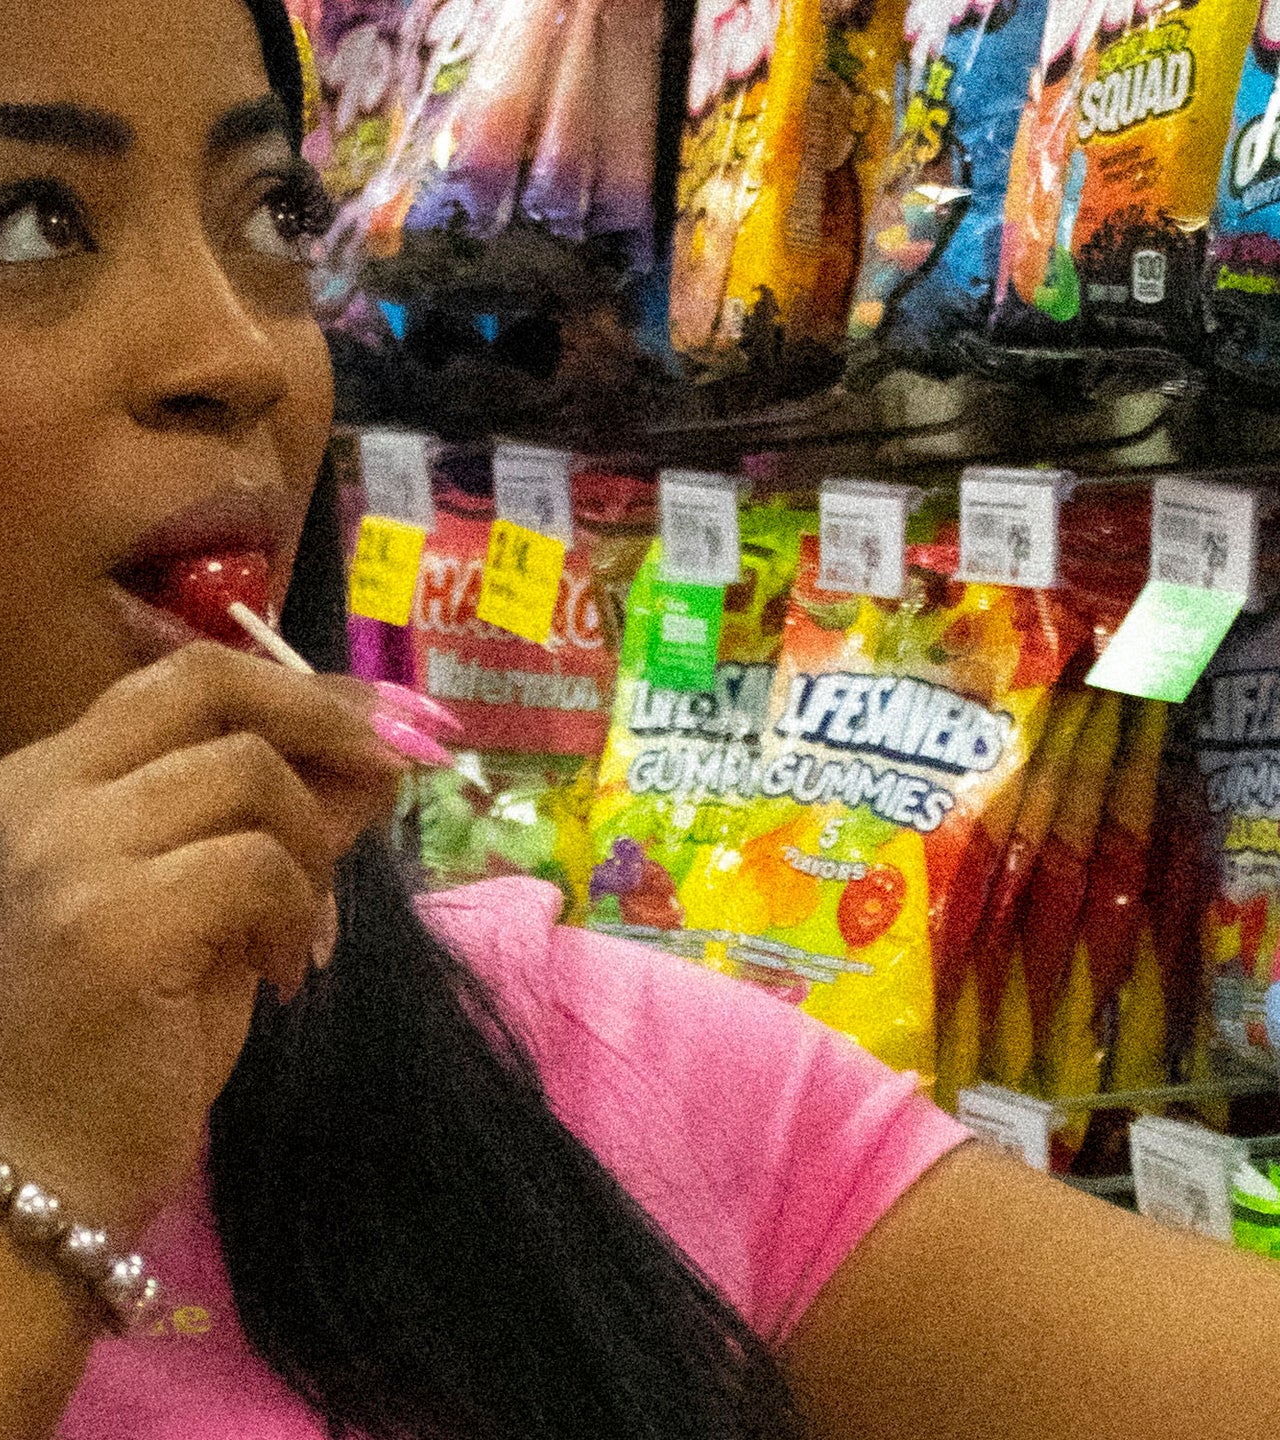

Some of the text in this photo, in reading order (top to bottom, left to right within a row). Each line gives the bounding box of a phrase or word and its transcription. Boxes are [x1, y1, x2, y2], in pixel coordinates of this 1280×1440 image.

[1081, 52, 1191, 138] SQUAD
[776, 673, 1011, 774] LIFESAVERS
[763, 754, 953, 832] GUMMIES
[820, 817, 842, 848] 5
